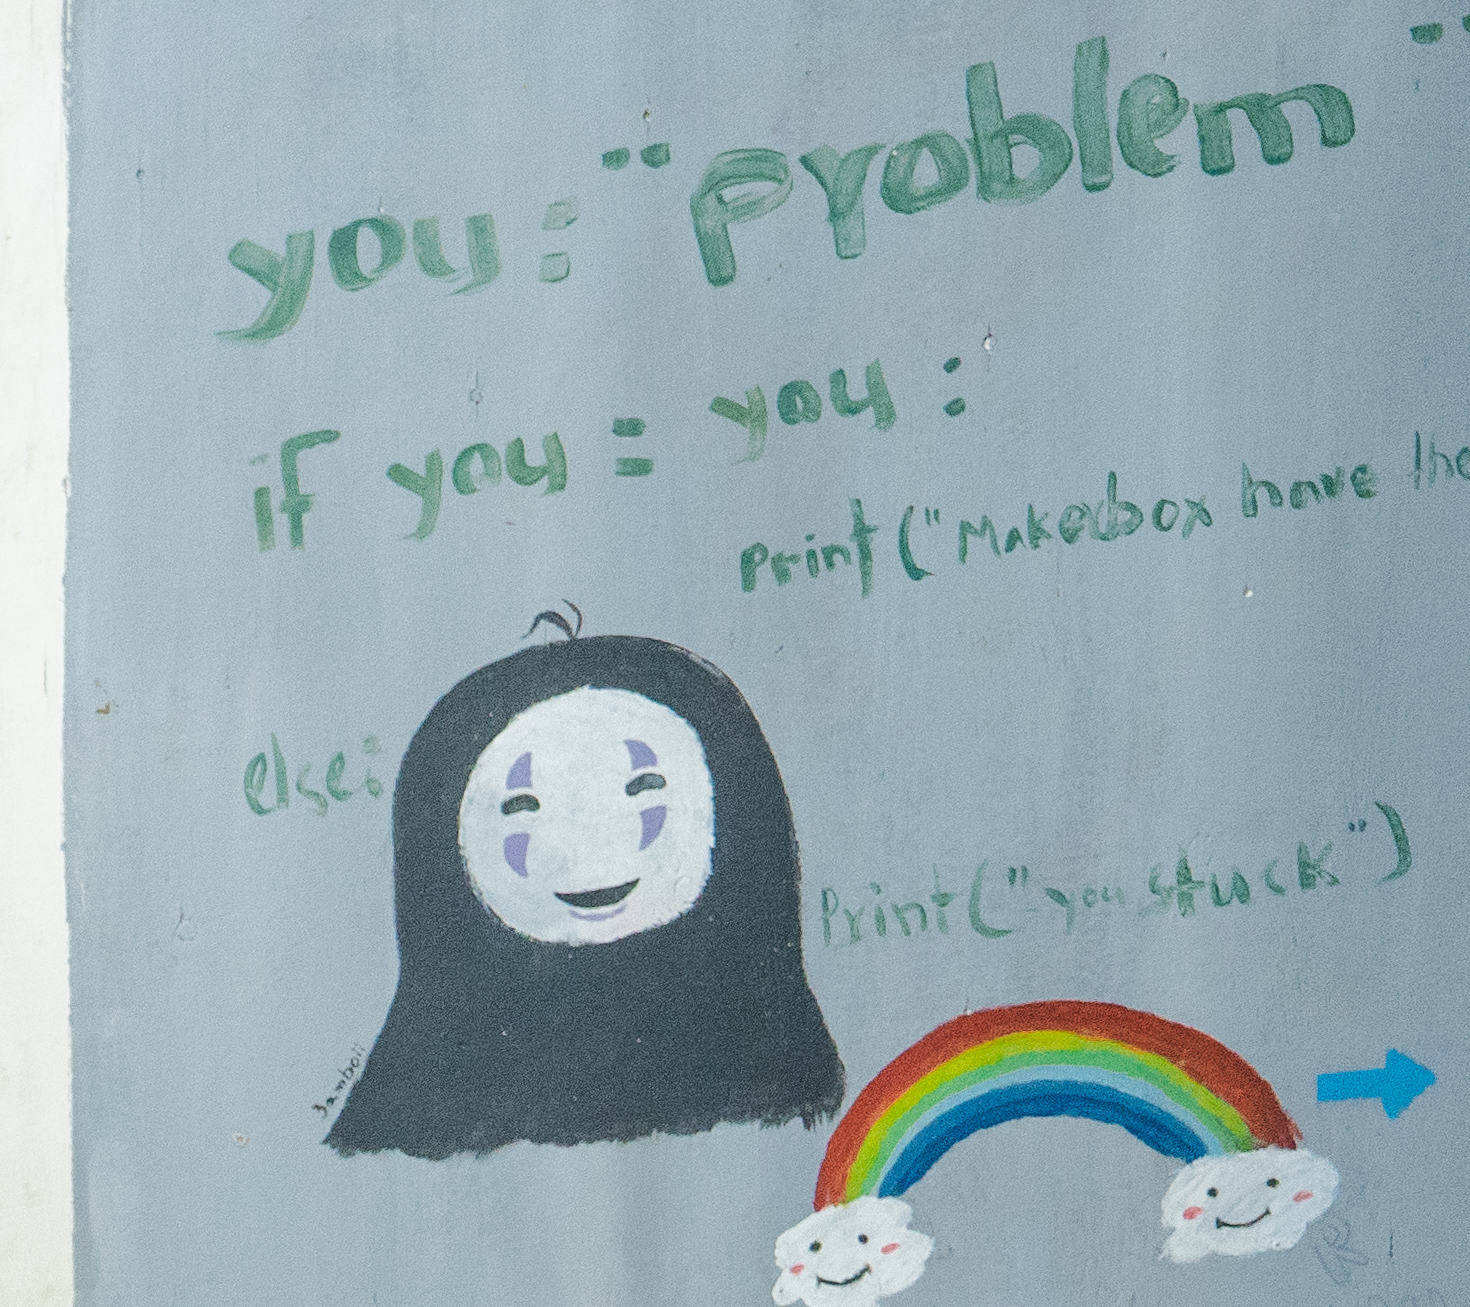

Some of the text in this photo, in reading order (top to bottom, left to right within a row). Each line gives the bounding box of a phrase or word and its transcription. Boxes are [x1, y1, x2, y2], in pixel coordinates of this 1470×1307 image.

[248, 429, 341, 551] if
[386, 432, 568, 542] you
[1241, 461, 1378, 519] have
